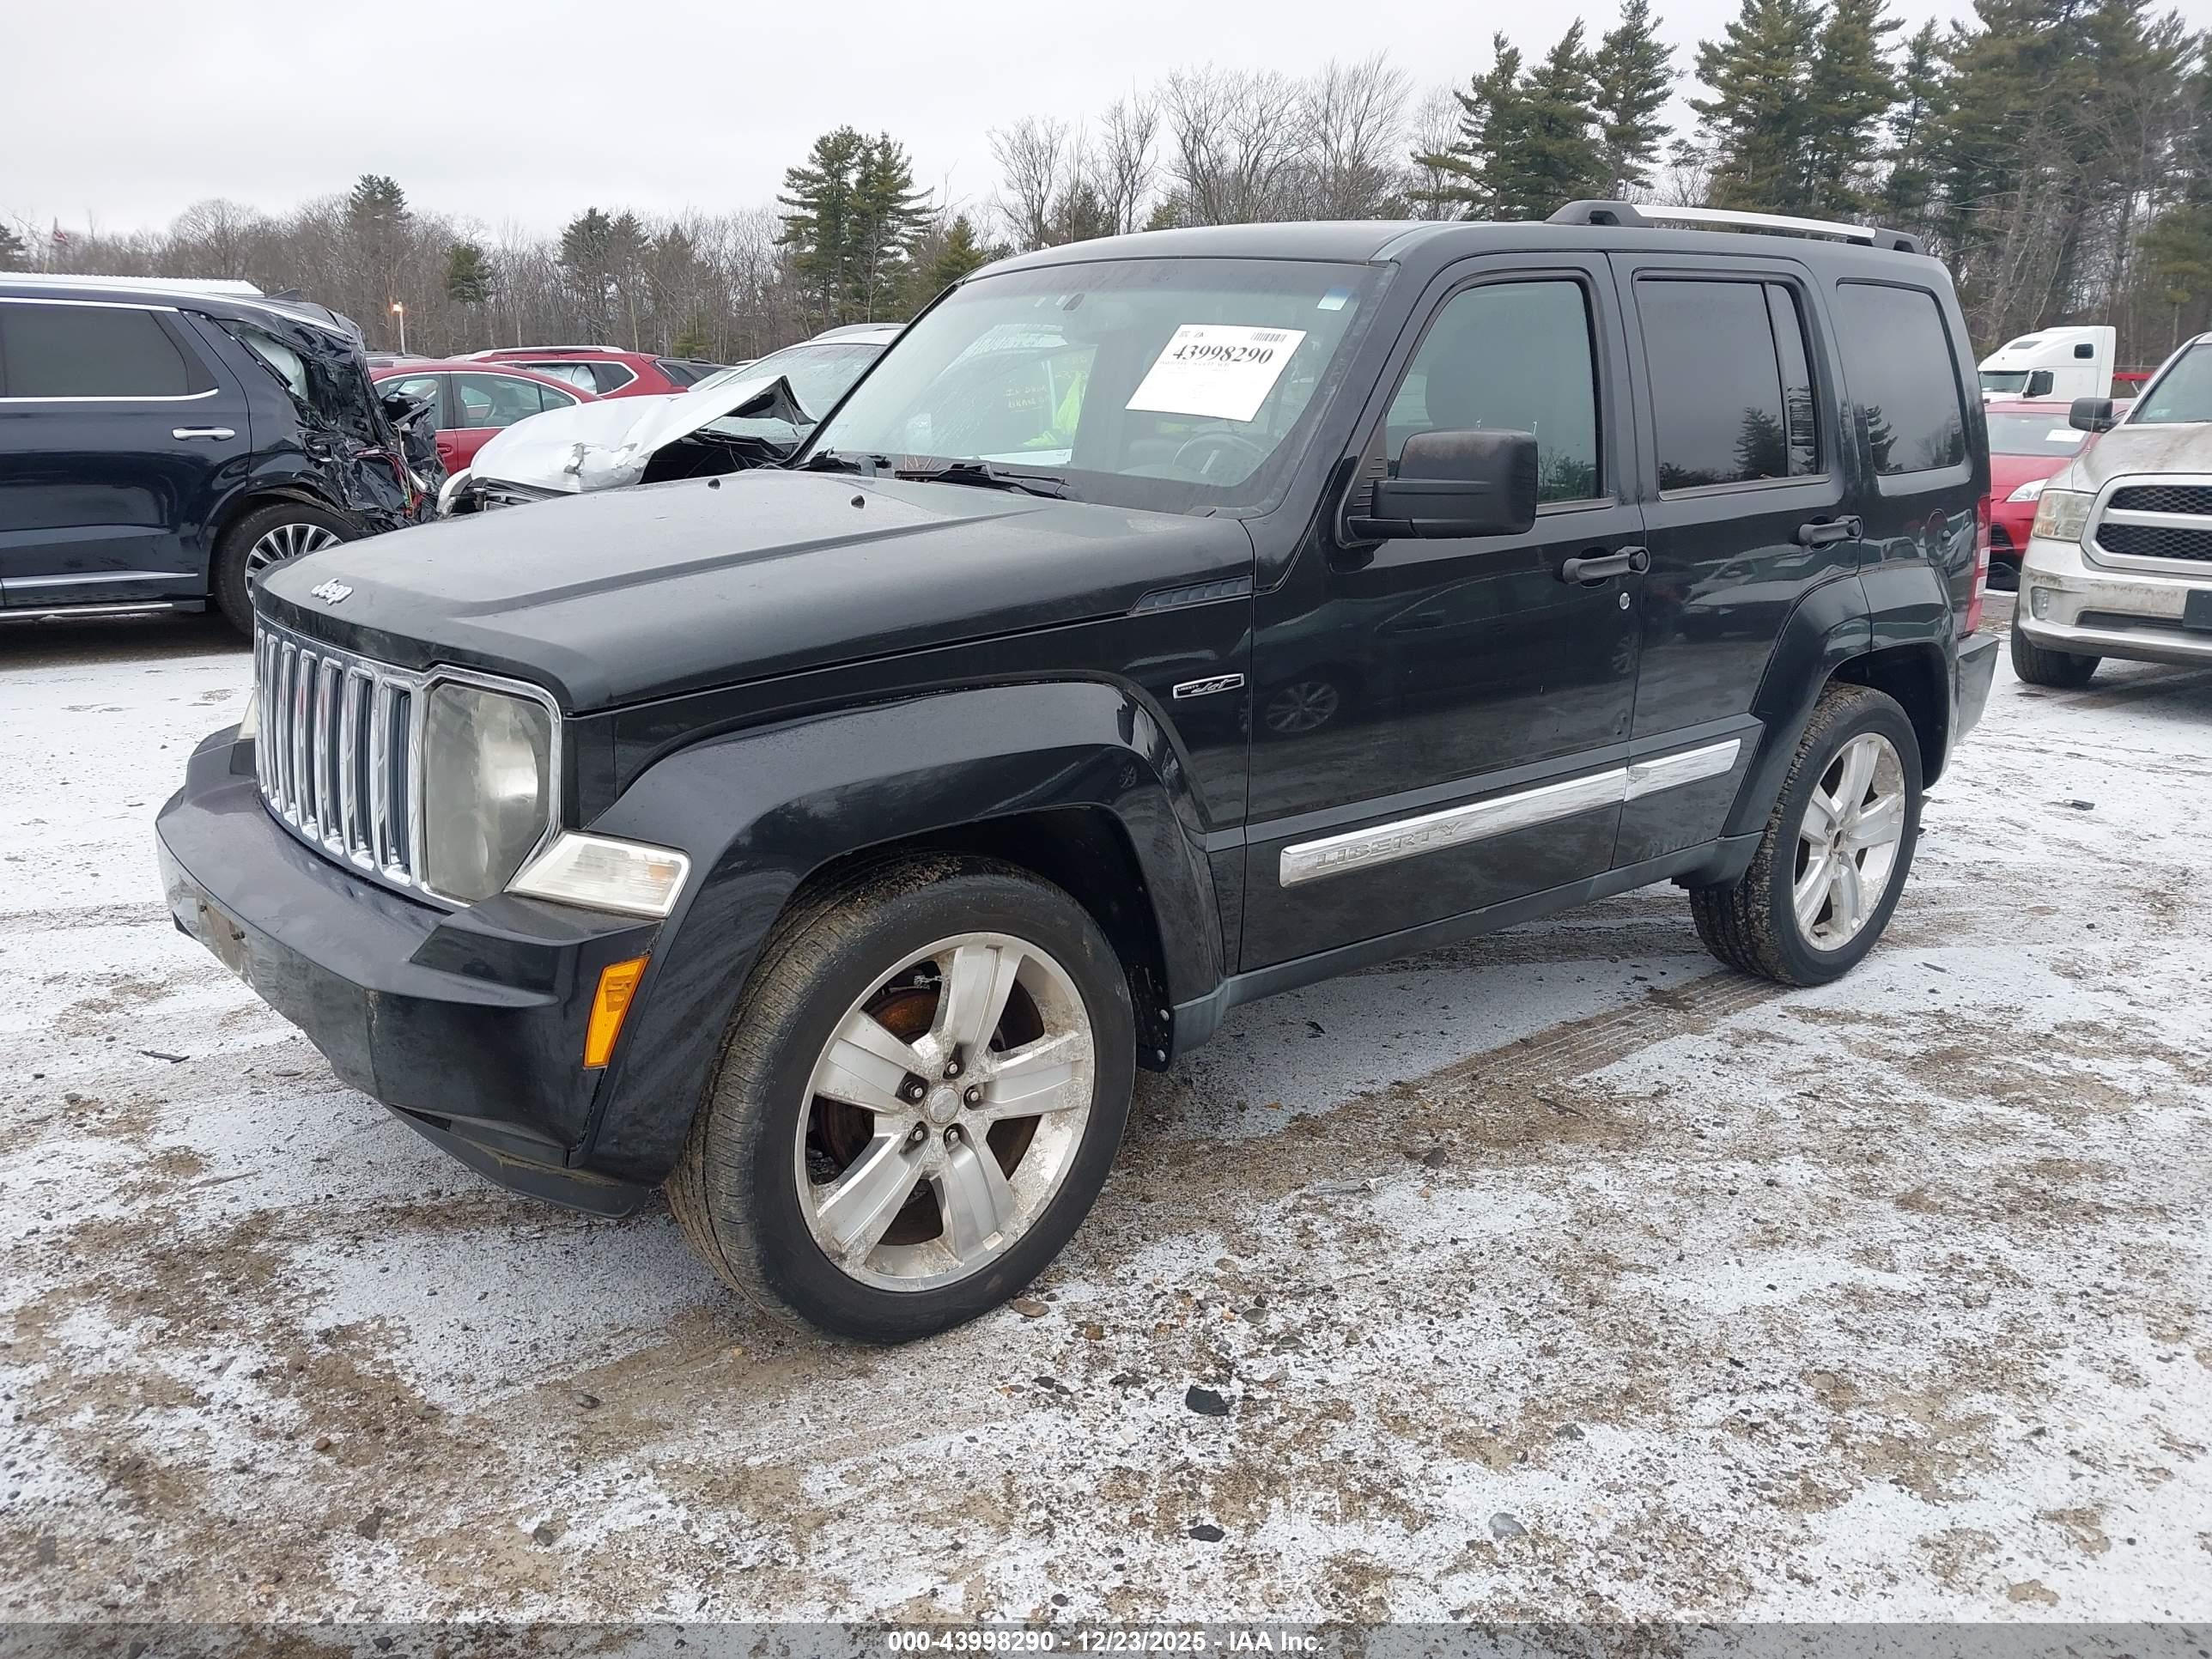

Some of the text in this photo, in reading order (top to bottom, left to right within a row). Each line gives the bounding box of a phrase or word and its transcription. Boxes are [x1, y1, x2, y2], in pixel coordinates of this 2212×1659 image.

[1173, 344, 1273, 364] 43998290
[311, 578, 354, 605] Jeep
[1190, 678, 1240, 694] Jet
[1316, 822, 1462, 870] LIBERTY
